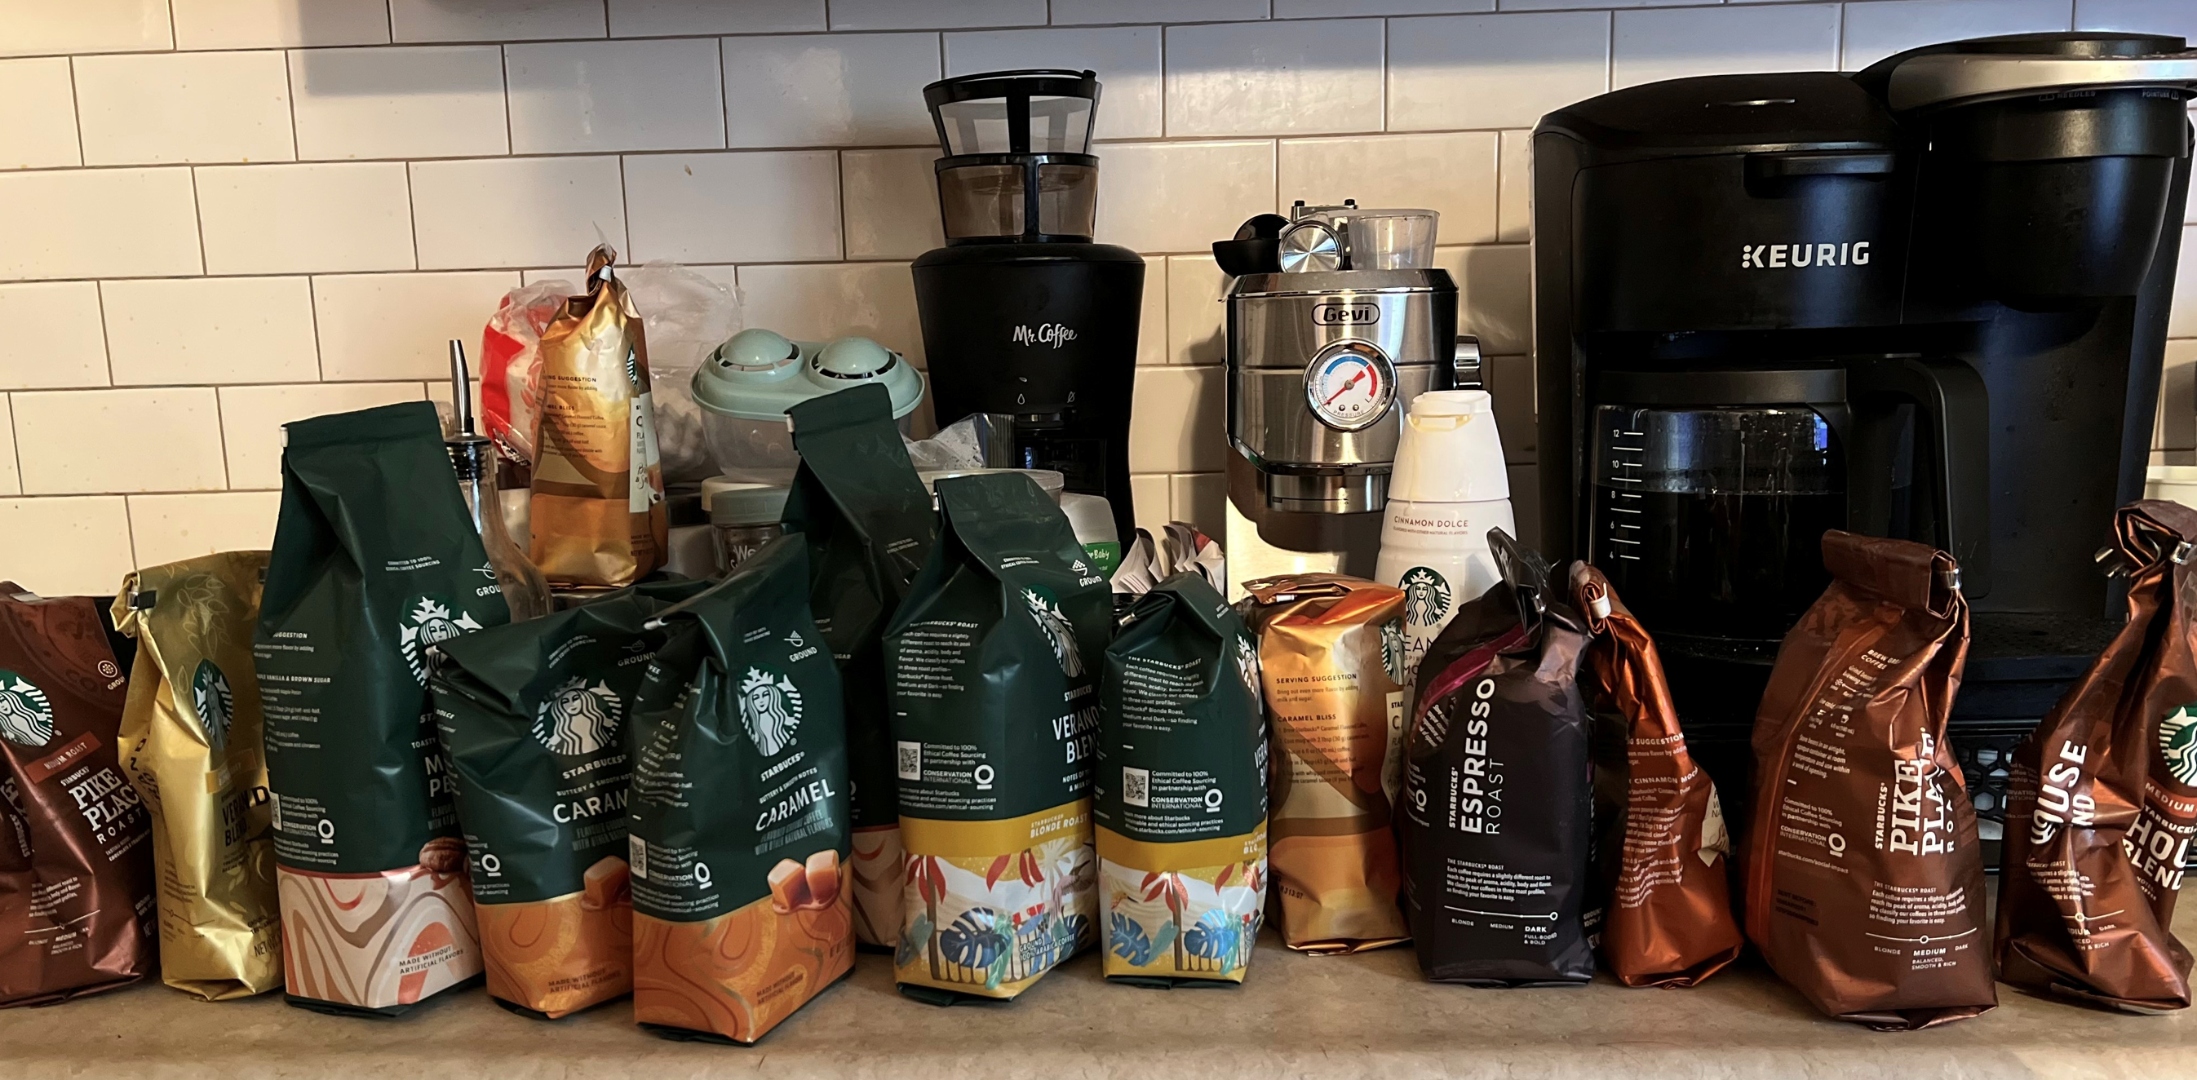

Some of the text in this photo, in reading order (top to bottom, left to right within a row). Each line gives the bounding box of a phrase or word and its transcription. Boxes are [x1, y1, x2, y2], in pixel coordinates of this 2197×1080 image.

[1742, 241, 1870, 269] KEURIG
[1323, 307, 1369, 322] Gevi
[1013, 323, 1077, 349] Mr. Coffee
[558, 375, 597, 383] SUGGESTION
[1613, 429, 1620, 437] 12
[1612, 460, 1620, 468] 10
[1611, 490, 1616, 499] 8
[1394, 515, 1468, 528] CINNAMON DOLCE
[1610, 520, 1615, 529] 6
[1609, 551, 1614, 559] 4
[475, 585, 502, 597] GROU
[617, 651, 656, 667] GROUND
[789, 646, 818, 662] GROUND
[1867, 649, 1888, 661] BREW
[1142, 658, 1182, 670] STARBUCKS
[1276, 673, 1357, 684] SERVING SUGGESTION
[1052, 706, 1099, 741] VERAND
[1277, 713, 1337, 723] CARAMEL BLISS
[411, 737, 436, 749] TOASTY
[1636, 732, 1684, 745] SUGGESTION
[923, 742, 954, 750] Committed
[1066, 732, 1096, 764] BLEN
[1460, 678, 1495, 834] ESPRESSO
[562, 755, 623, 780] STARBUCKS
[760, 753, 801, 782] STARBUCKS
[798, 766, 818, 780] NOTES
[923, 769, 972, 779] CONSERVATION
[1151, 770, 1185, 778] Committed
[923, 776, 972, 785] INTERNATIONAL
[1062, 772, 1078, 783] NOTES
[1634, 776, 1678, 784] CINNAMON
[68, 767, 122, 811] PIKE
[556, 784, 588, 797] BUTTERY
[1151, 796, 1203, 804] CONSERVATION
[1449, 769, 1459, 829] STARBUCKS
[1485, 758, 1504, 835] ROAST
[1784, 796, 1811, 809] Committed
[2145, 782, 2195, 813] MEDIUM
[82, 784, 140, 832] PLAC
[755, 778, 836, 831] CARAMEL
[1151, 802, 1202, 810] INTERNATIONAL
[1889, 759, 1923, 856] PIKE
[1200, 818, 1224, 826] practices
[1787, 813, 1831, 830] partnership with
[1800, 808, 1818, 819] Coffee
[1818, 814, 1843, 828] Sourcing
[1874, 786, 1888, 850] STARBUCKS
[95, 808, 142, 845] ROAST
[807, 816, 834, 835] FLAVORS
[1030, 813, 1088, 839] BLONDE ROAST
[1779, 830, 1826, 848] INTERNATIONAL
[1780, 825, 1827, 842] CONSERVATION
[2126, 813, 2190, 868] HOU
[1447, 857, 1456, 865] THE
[1457, 860, 1485, 869] STARBUCKS
[1447, 865, 1458, 873] Each
[1513, 873, 1534, 881] different
[1455, 881, 1470, 890] classify
[1884, 883, 1916, 894] STARBUCKS
[1480, 891, 1498, 899] favorite
[1872, 889, 1885, 898] Each
[1885, 893, 1901, 902] coffee
[1451, 917, 1474, 927] BLONDE
[1524, 925, 1547, 933] DARK
[399, 945, 451, 967] MADE WITHOUT
[1874, 943, 1969, 957] BLONDE MEDIUM DARK
[400, 949, 464, 974] ARTIFICIAL FLAVORS
[1911, 963, 1936, 971] SMOOTH
[1912, 957, 1944, 965] BALANCED,
[548, 978, 570, 987] MADE
